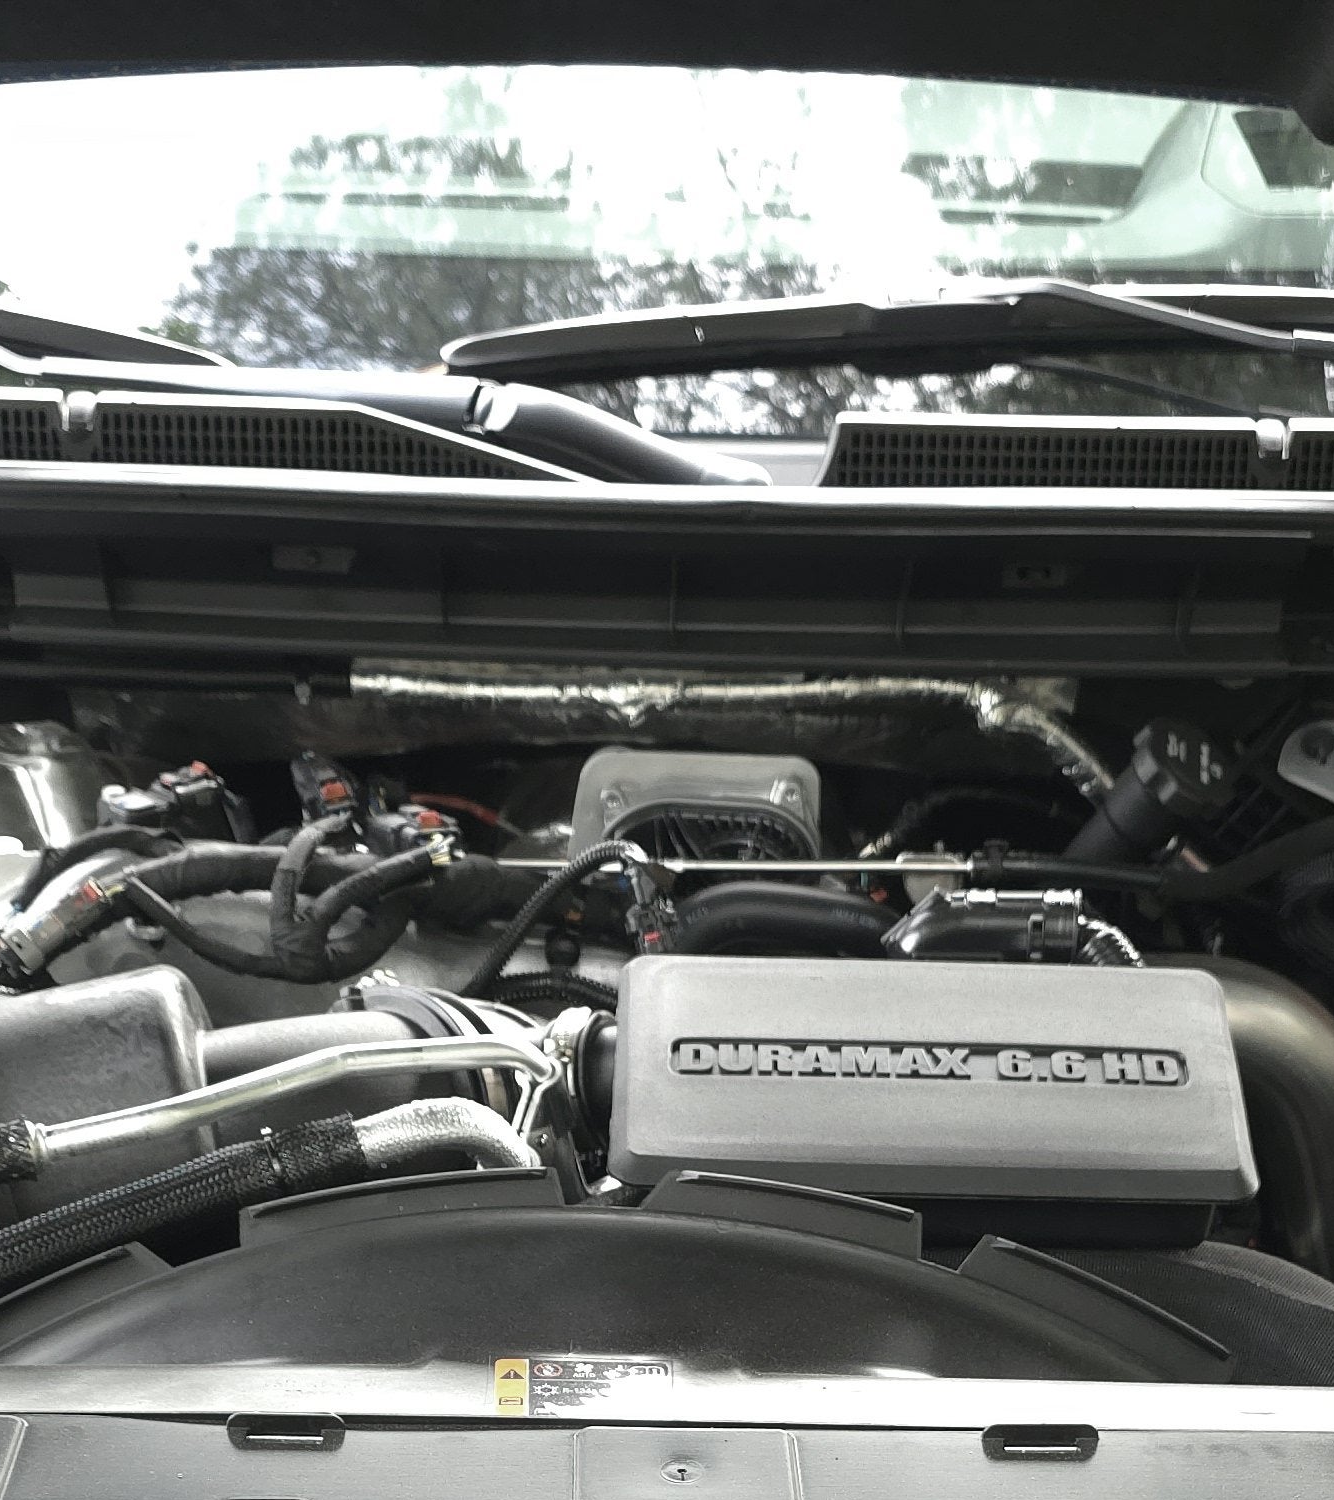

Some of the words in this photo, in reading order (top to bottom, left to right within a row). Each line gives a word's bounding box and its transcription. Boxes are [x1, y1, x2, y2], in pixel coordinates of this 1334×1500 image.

[678, 1043, 971, 1079] DURAMAX
[996, 1049, 1087, 1083] 6.6
[1102, 1052, 1179, 1085] HD
